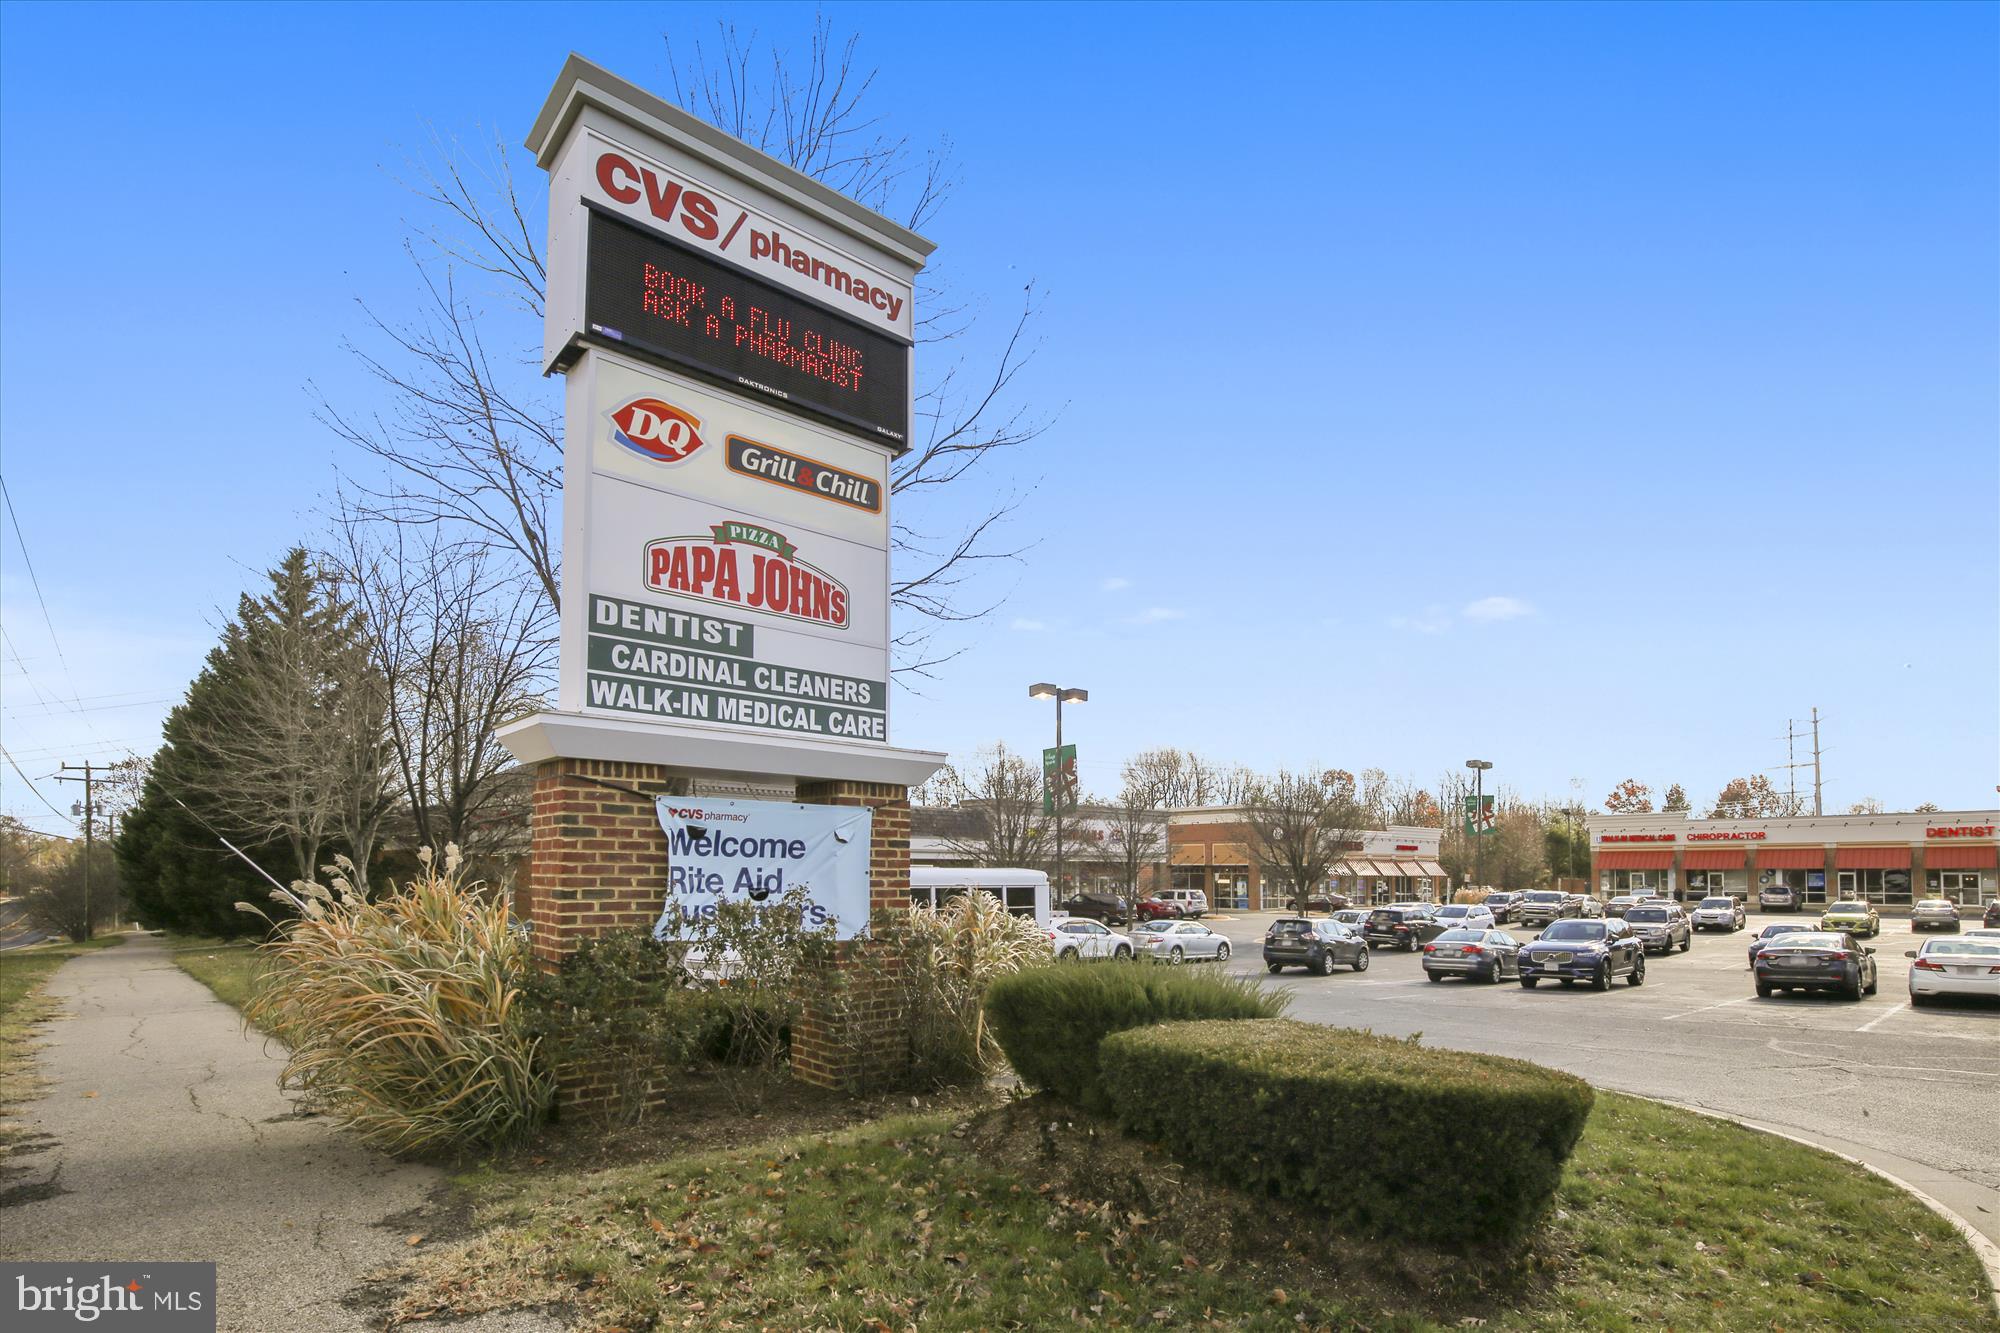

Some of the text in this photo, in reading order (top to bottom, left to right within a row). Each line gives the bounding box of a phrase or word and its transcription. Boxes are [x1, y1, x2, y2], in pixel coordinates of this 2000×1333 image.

[644, 262, 864, 371] BOOK A FLU CLINIC
[643, 289, 864, 392] ASK A PHARMACIST
[738, 376, 789, 399] DAKTRONICS
[626, 406, 692, 456] DQ
[876, 426, 902, 439] GALAXY
[730, 524, 781, 549] PIZZA
[650, 546, 846, 624] PAPA JOHN'S
[596, 599, 743, 647] DENTIST
[611, 644, 871, 705] CARDINAL CLEANERS
[591, 679, 884, 739] WALK-IN MEDICAL CARE
[679, 808, 749, 823] CVS pharmacy
[1926, 825, 1995, 838] DENTIST
[669, 827, 807, 860] Welcome
[1686, 831, 1766, 841] CHIROPRACTOR
[670, 865, 783, 895] Rite Aid
